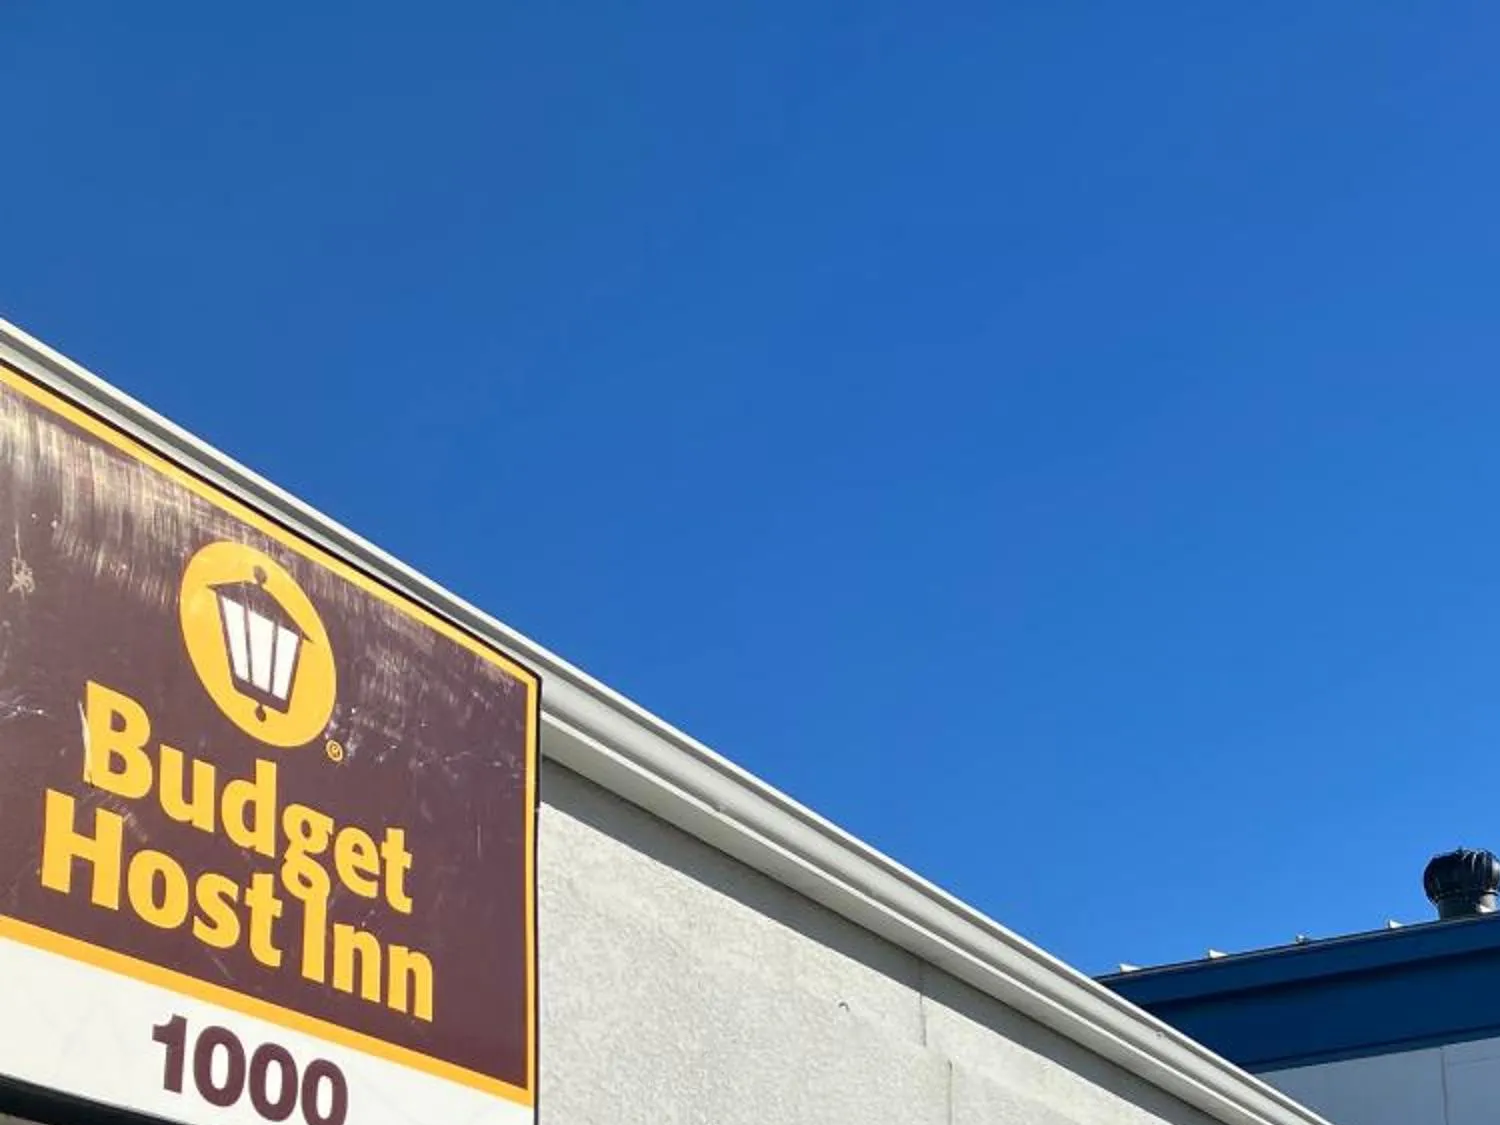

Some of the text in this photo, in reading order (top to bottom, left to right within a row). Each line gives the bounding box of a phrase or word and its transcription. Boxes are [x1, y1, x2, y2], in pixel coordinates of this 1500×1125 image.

[40, 790, 434, 1022] Host Inn
[85, 681, 413, 914] Budget
